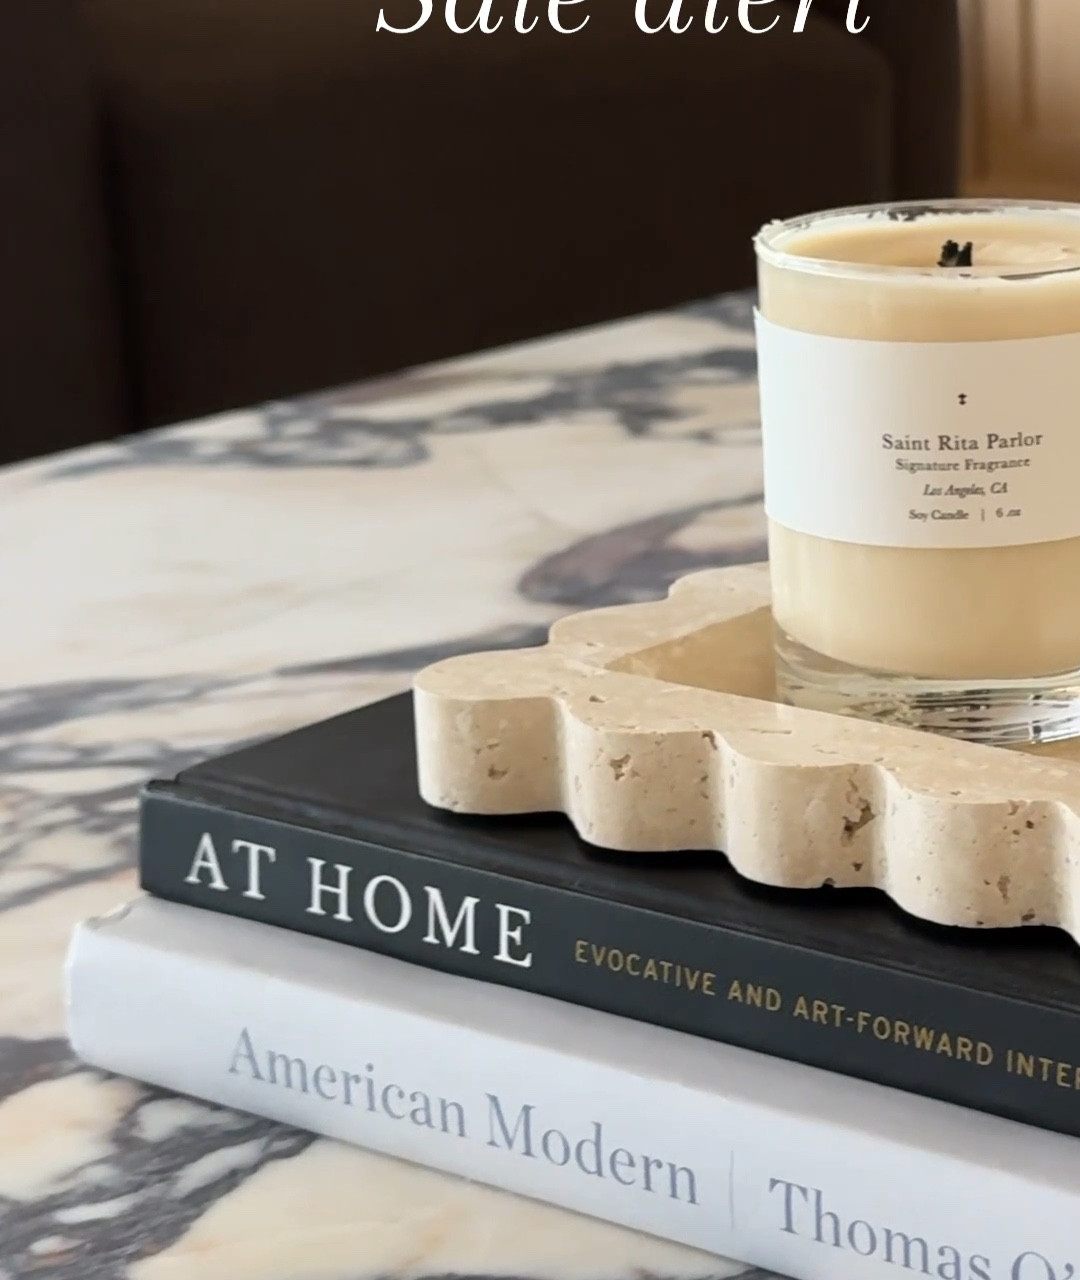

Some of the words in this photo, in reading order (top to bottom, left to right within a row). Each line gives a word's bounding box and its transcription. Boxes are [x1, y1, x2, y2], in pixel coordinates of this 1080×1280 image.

[882, 433, 931, 451] Saint
[938, 434, 979, 451] Rita
[987, 431, 1043, 450] Parlor
[895, 458, 960, 474] Signature
[964, 458, 1031, 473] Fragrance
[923, 483, 942, 496] Los
[990, 482, 1008, 494] CA
[908, 509, 928, 522] Soy
[930, 509, 969, 520] Candle
[184, 832, 276, 901] AT
[306, 856, 532, 968] HOME
[575, 939, 716, 997] EVOCATIVE
[728, 980, 782, 1012] AND
[793, 995, 994, 1067] ART-FORWARD
[228, 1027, 467, 1138] American
[485, 1093, 699, 1206] Modern
